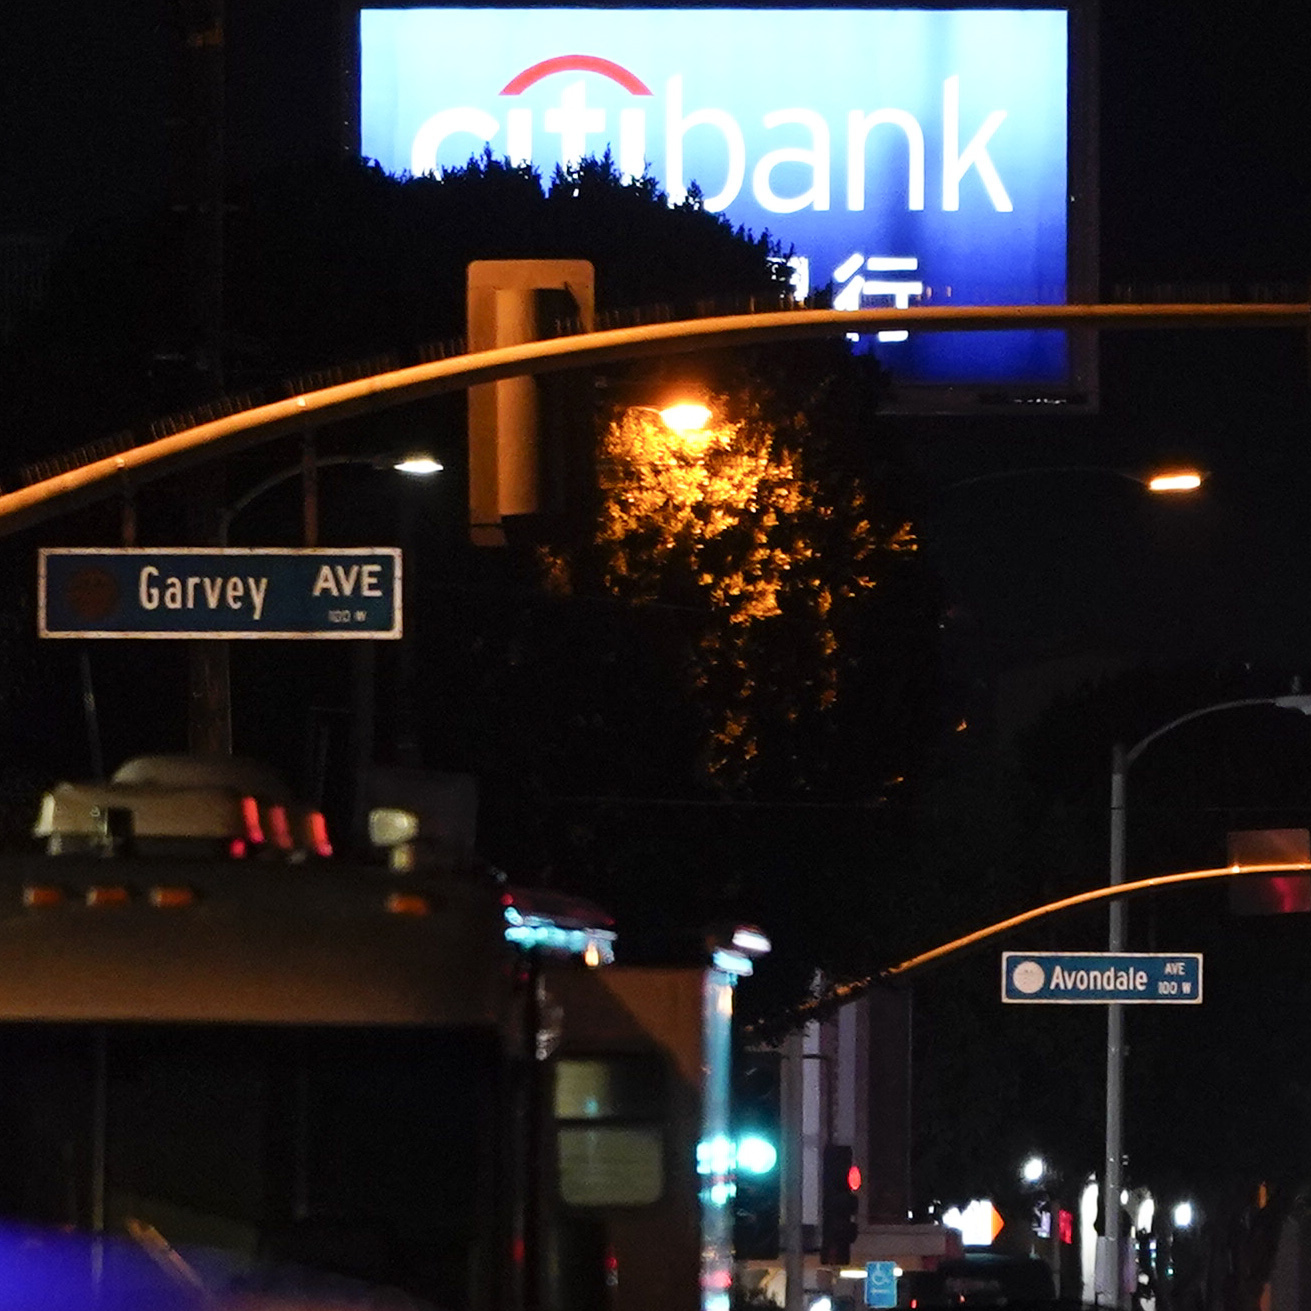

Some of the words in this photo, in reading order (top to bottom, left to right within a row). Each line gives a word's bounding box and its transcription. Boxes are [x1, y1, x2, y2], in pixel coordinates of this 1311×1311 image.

[411, 74, 1014, 213] citibank
[138, 566, 268, 621] Garvey
[312, 564, 384, 597] AVE
[1049, 965, 1149, 991] Avondale
[1164, 961, 1186, 976] AVE
[1157, 981, 1178, 995] 100
[1182, 981, 1192, 995] W
